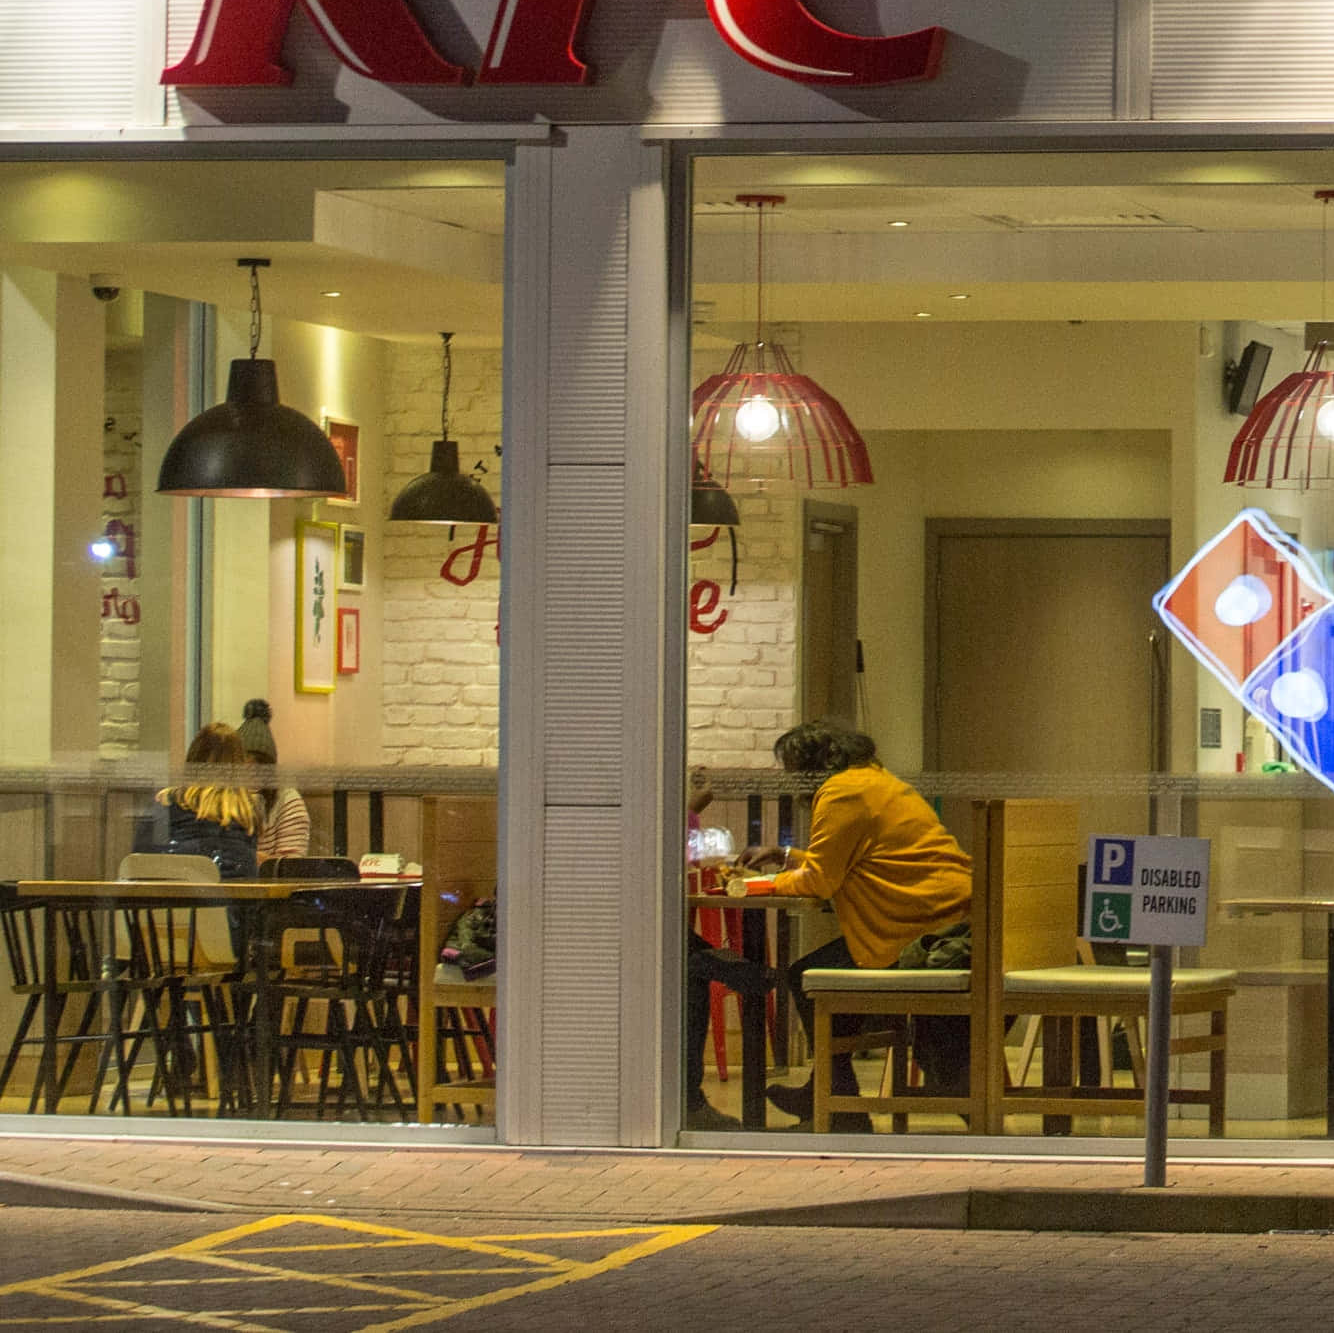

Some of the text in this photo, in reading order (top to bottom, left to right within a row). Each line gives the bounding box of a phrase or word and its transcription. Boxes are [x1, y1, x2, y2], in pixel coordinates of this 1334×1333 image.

[1102, 842, 1126, 882] P
[1141, 868, 1201, 888] DISABLED
[1142, 895, 1197, 915] PARKING
